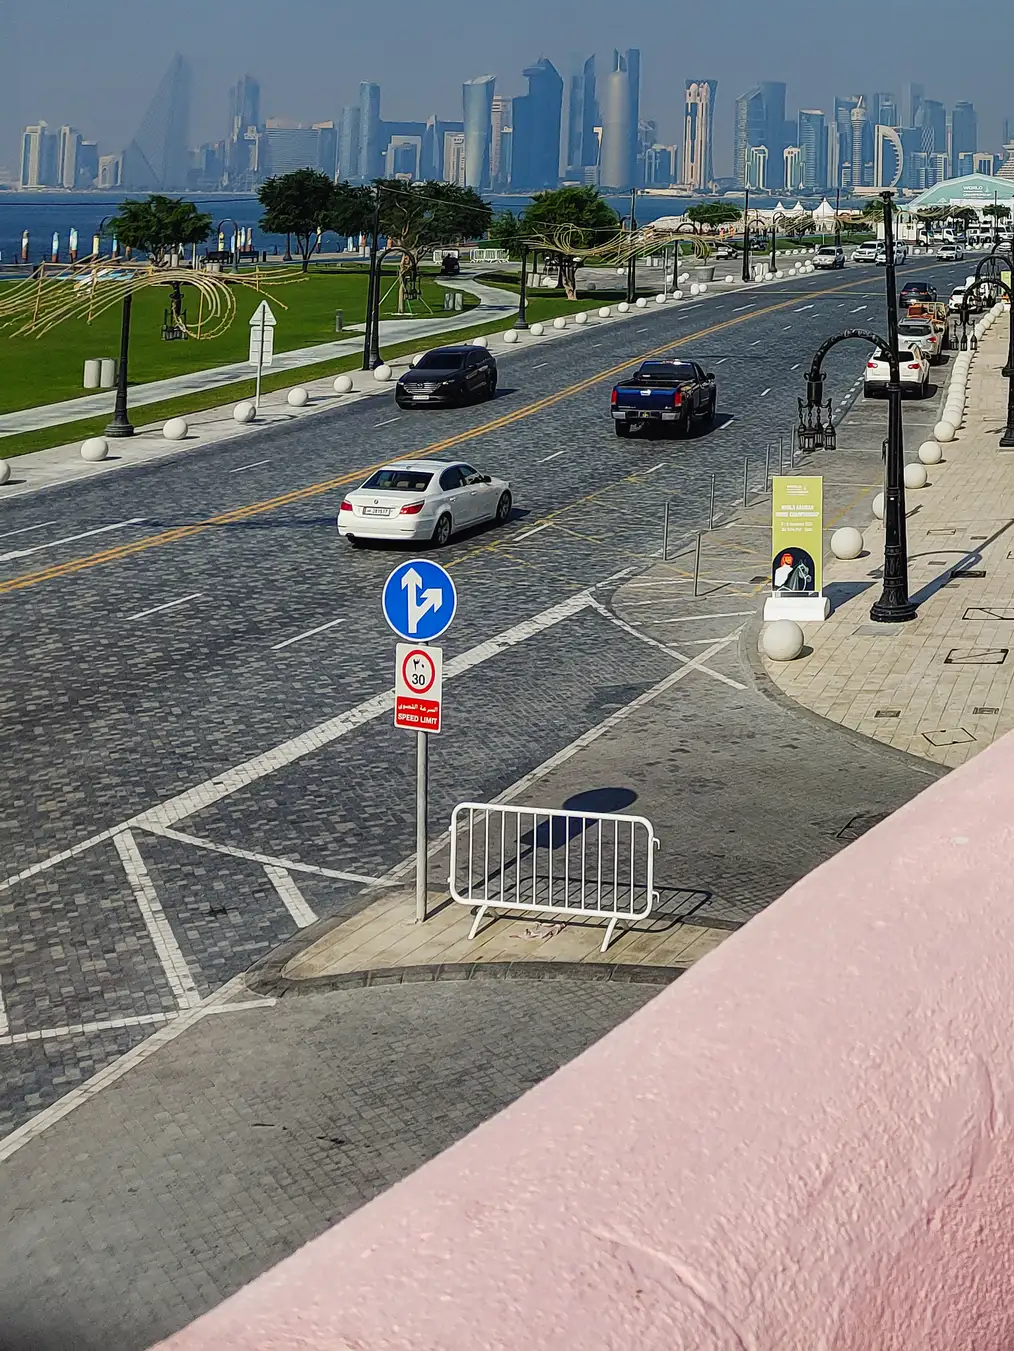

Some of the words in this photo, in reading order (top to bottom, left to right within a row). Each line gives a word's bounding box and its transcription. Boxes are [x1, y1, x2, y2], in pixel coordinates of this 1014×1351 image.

[411, 673, 426, 686] 30
[398, 713, 419, 722] SPEED
[419, 716, 437, 724] LIMIT
